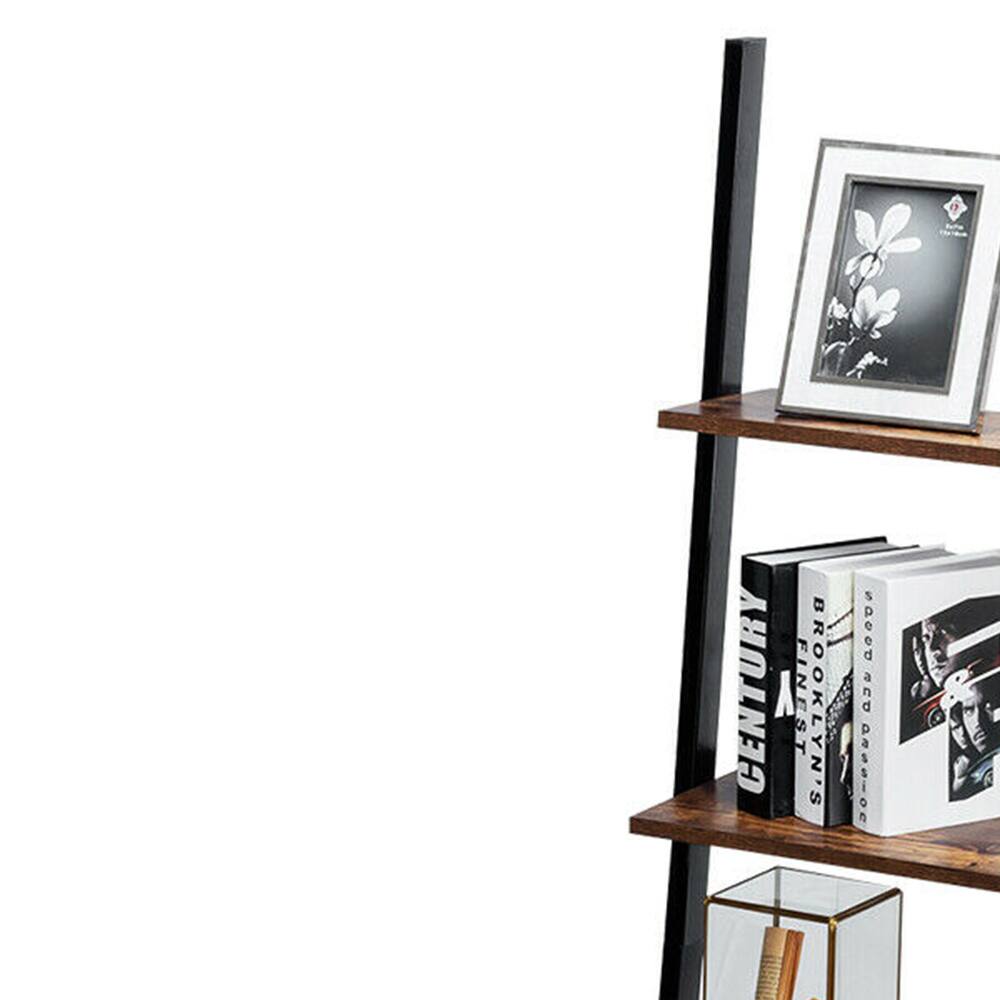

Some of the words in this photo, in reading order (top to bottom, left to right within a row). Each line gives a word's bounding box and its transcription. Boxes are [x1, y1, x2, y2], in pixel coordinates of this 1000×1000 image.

[863, 590, 874, 661] speed
[737, 586, 768, 795] CENTURY
[795, 637, 808, 756] FINEST
[808, 597, 825, 806] BROOKLYN'S
[861, 672, 872, 713] and
[859, 723, 871, 824] passion
